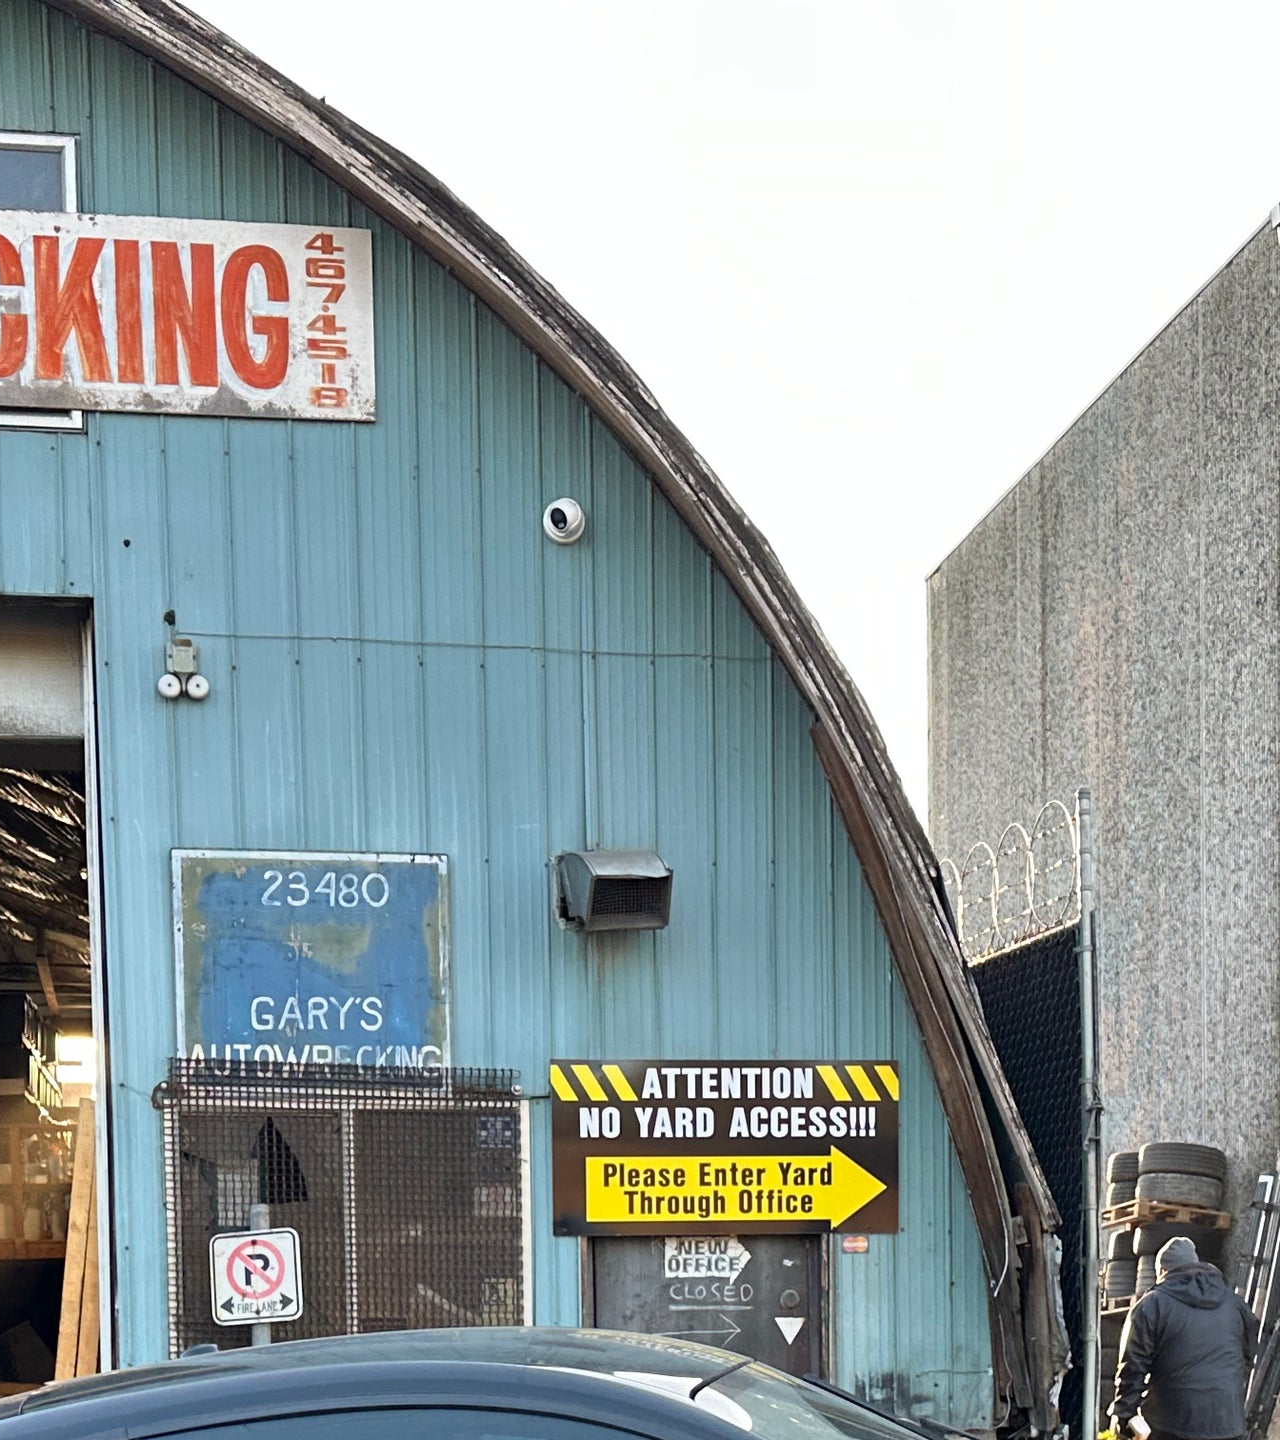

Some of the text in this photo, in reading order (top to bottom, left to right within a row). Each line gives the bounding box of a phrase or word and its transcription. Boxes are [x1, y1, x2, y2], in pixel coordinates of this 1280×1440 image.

[261, 870, 390, 908] 23480
[250, 996, 383, 1031] GARY'S
[641, 1066, 814, 1099] ATTENTION
[578, 1106, 876, 1139] NO YARD ACCESS!!!
[603, 1161, 833, 1187] Please Enter Yard
[623, 1190, 813, 1218] Through Office
[677, 1239, 728, 1254] NEW
[668, 1255, 741, 1272] OFFICE
[669, 1282, 754, 1302] CLOSED
